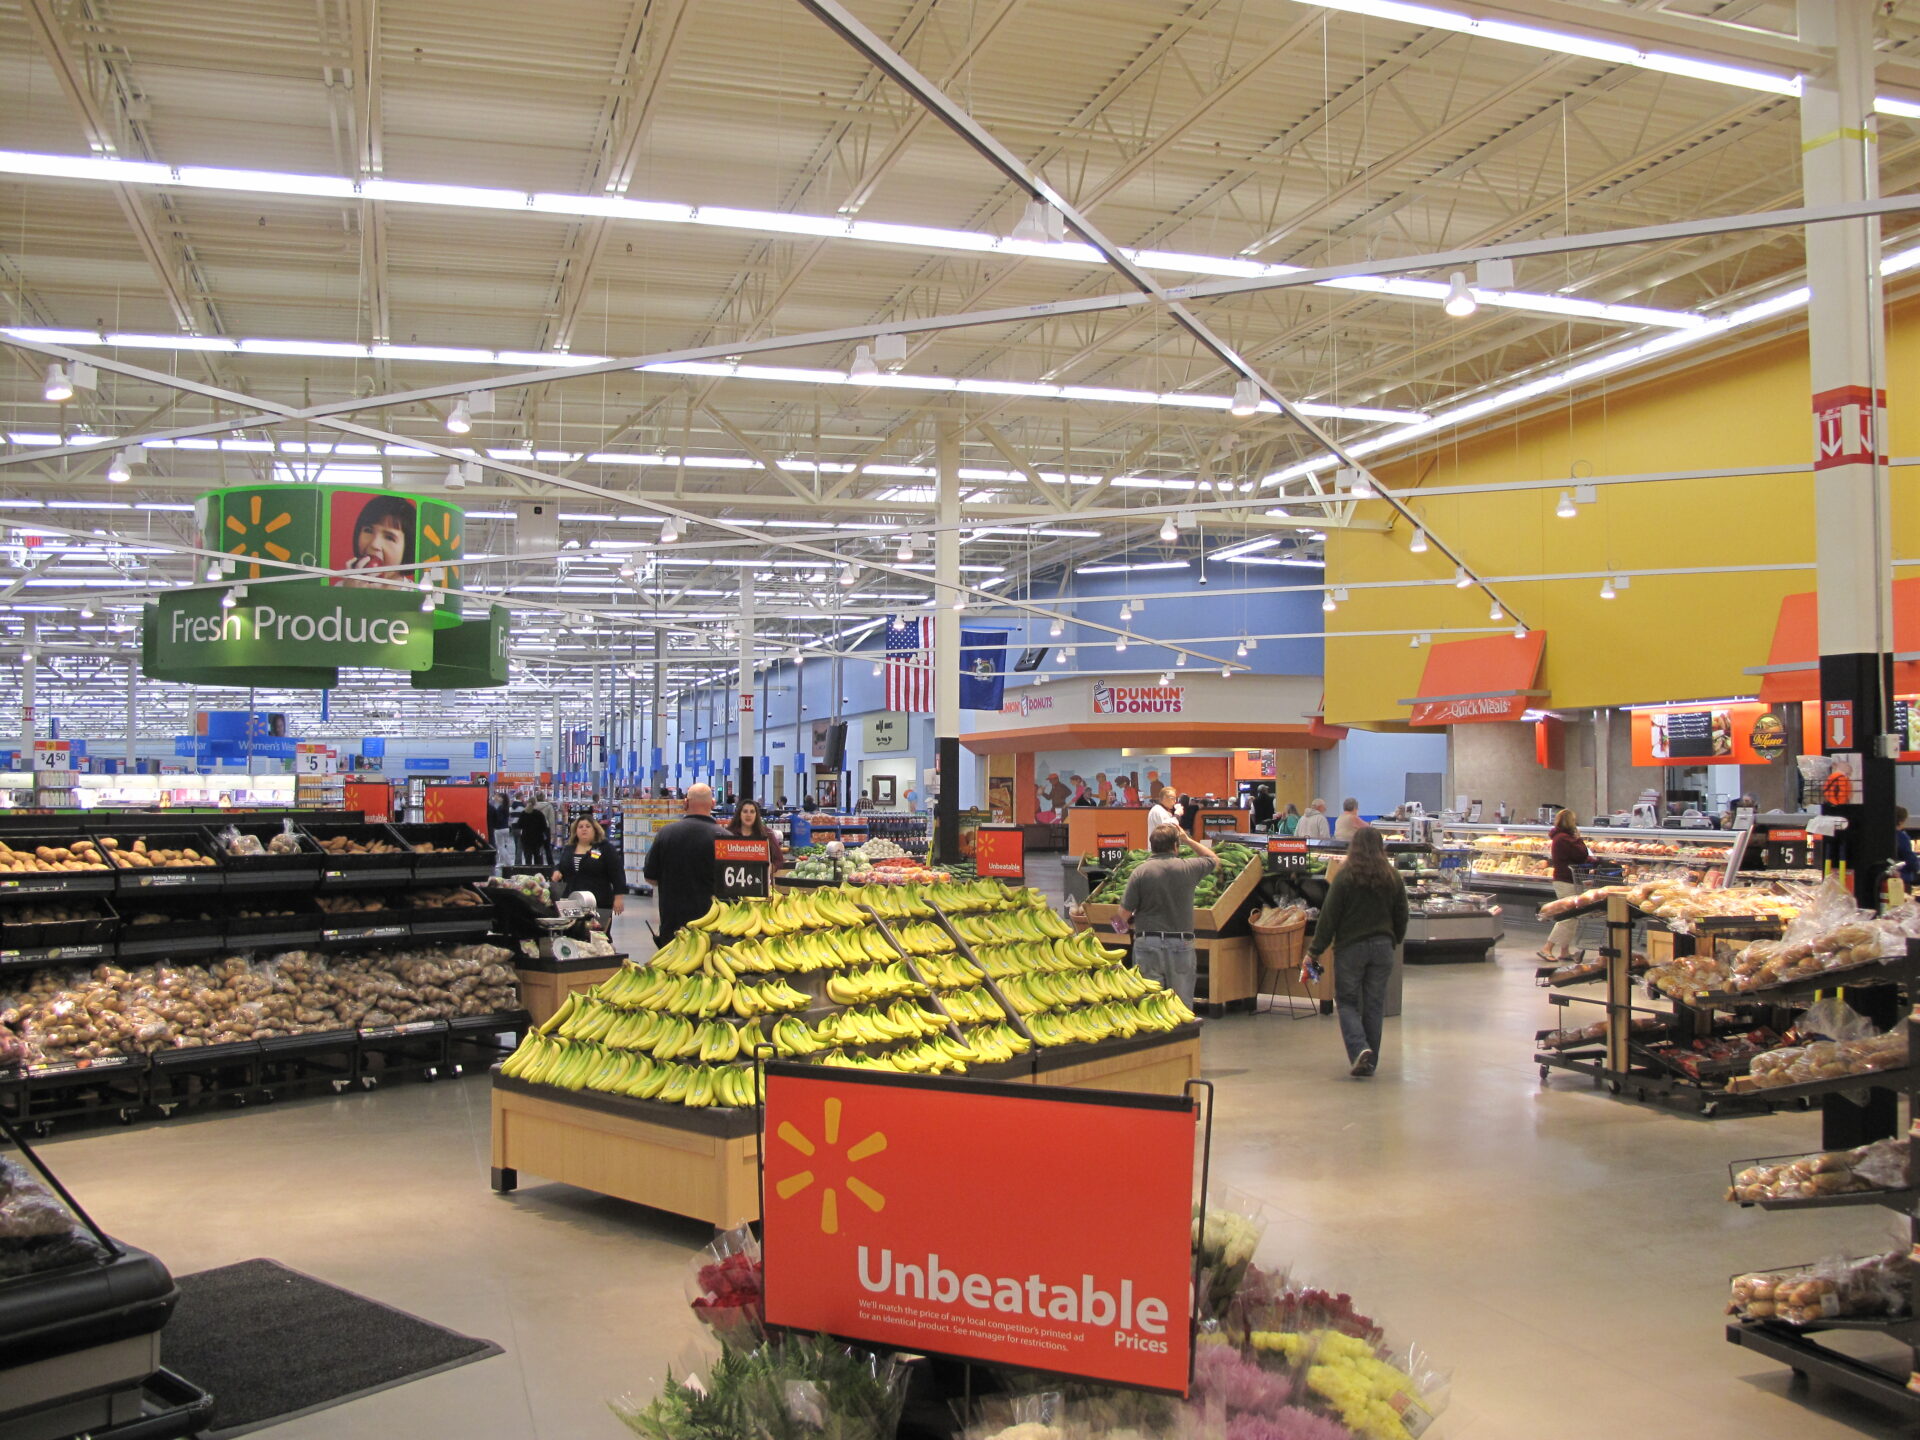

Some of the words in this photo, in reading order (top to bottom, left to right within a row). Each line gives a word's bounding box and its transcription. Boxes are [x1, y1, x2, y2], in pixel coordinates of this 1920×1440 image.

[172, 607, 241, 643] Fresh
[254, 606, 410, 645] Produce
[1116, 687, 1185, 700] DUNKIN'
[1029, 696, 1053, 710] DONUTS
[1116, 700, 1182, 713] DONUTS
[1451, 701, 1479, 717] Quick
[1480, 701, 1509, 714] Meals
[306, 755, 318, 771] $5
[727, 844, 766, 853] Unbeatable
[1780, 846, 1794, 864] $5
[988, 861, 1021, 871] Unbeatable
[724, 866, 753, 887] 64¢
[858, 1245, 1169, 1334] Unbeatable
[858, 1298, 878, 1309] We'll
[878, 1303, 904, 1313] match
[905, 1306, 918, 1316] the
[919, 1309, 940, 1319] price
[941, 1312, 950, 1320] of
[951, 1315, 965, 1325] any
[967, 1315, 986, 1327] local
[987, 1320, 1039, 1335] competitor's
[1040, 1328, 1072, 1339] printed
[1073, 1332, 1085, 1342] ad
[859, 1310, 870, 1319] for
[871, 1314, 882, 1322] an
[882, 1315, 917, 1327] identical
[917, 1321, 951, 1333] product.
[953, 1325, 968, 1336] See
[969, 1329, 1005, 1342] manager
[1007, 1333, 1018, 1343] for
[1020, 1337, 1070, 1351] restrictions.
[1114, 1331, 1168, 1354] Prices
